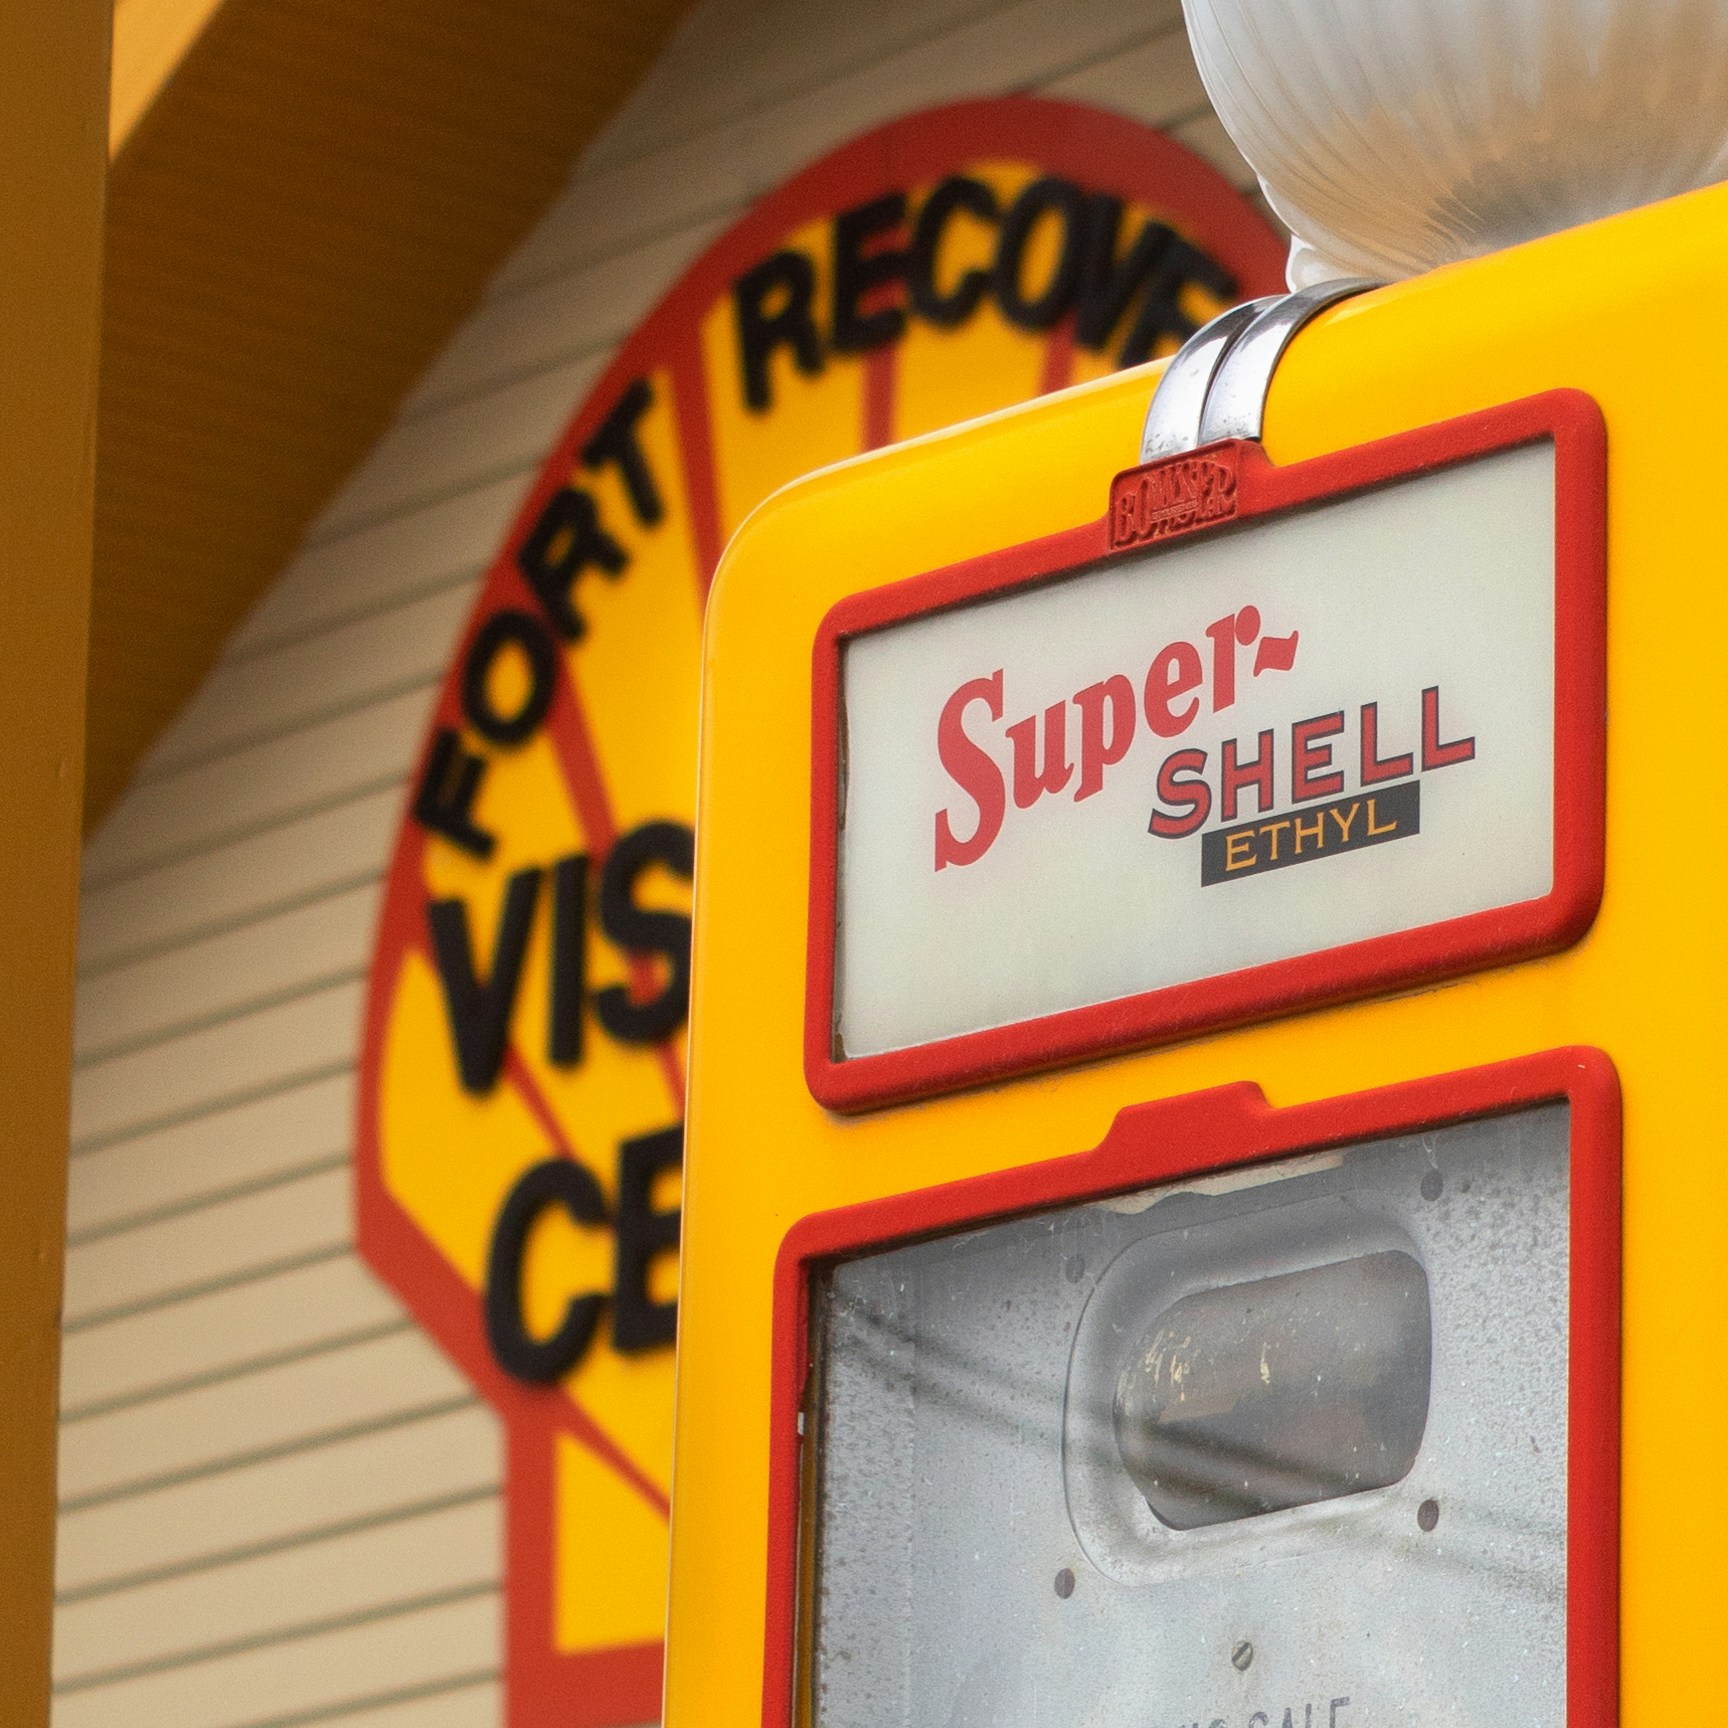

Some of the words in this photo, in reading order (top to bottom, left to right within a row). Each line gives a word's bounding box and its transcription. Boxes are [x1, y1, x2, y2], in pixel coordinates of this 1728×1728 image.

[413, 375, 666, 862] FORT
[1148, 685, 1476, 839] SHELL
[1224, 799, 1397, 872] ETHYL
